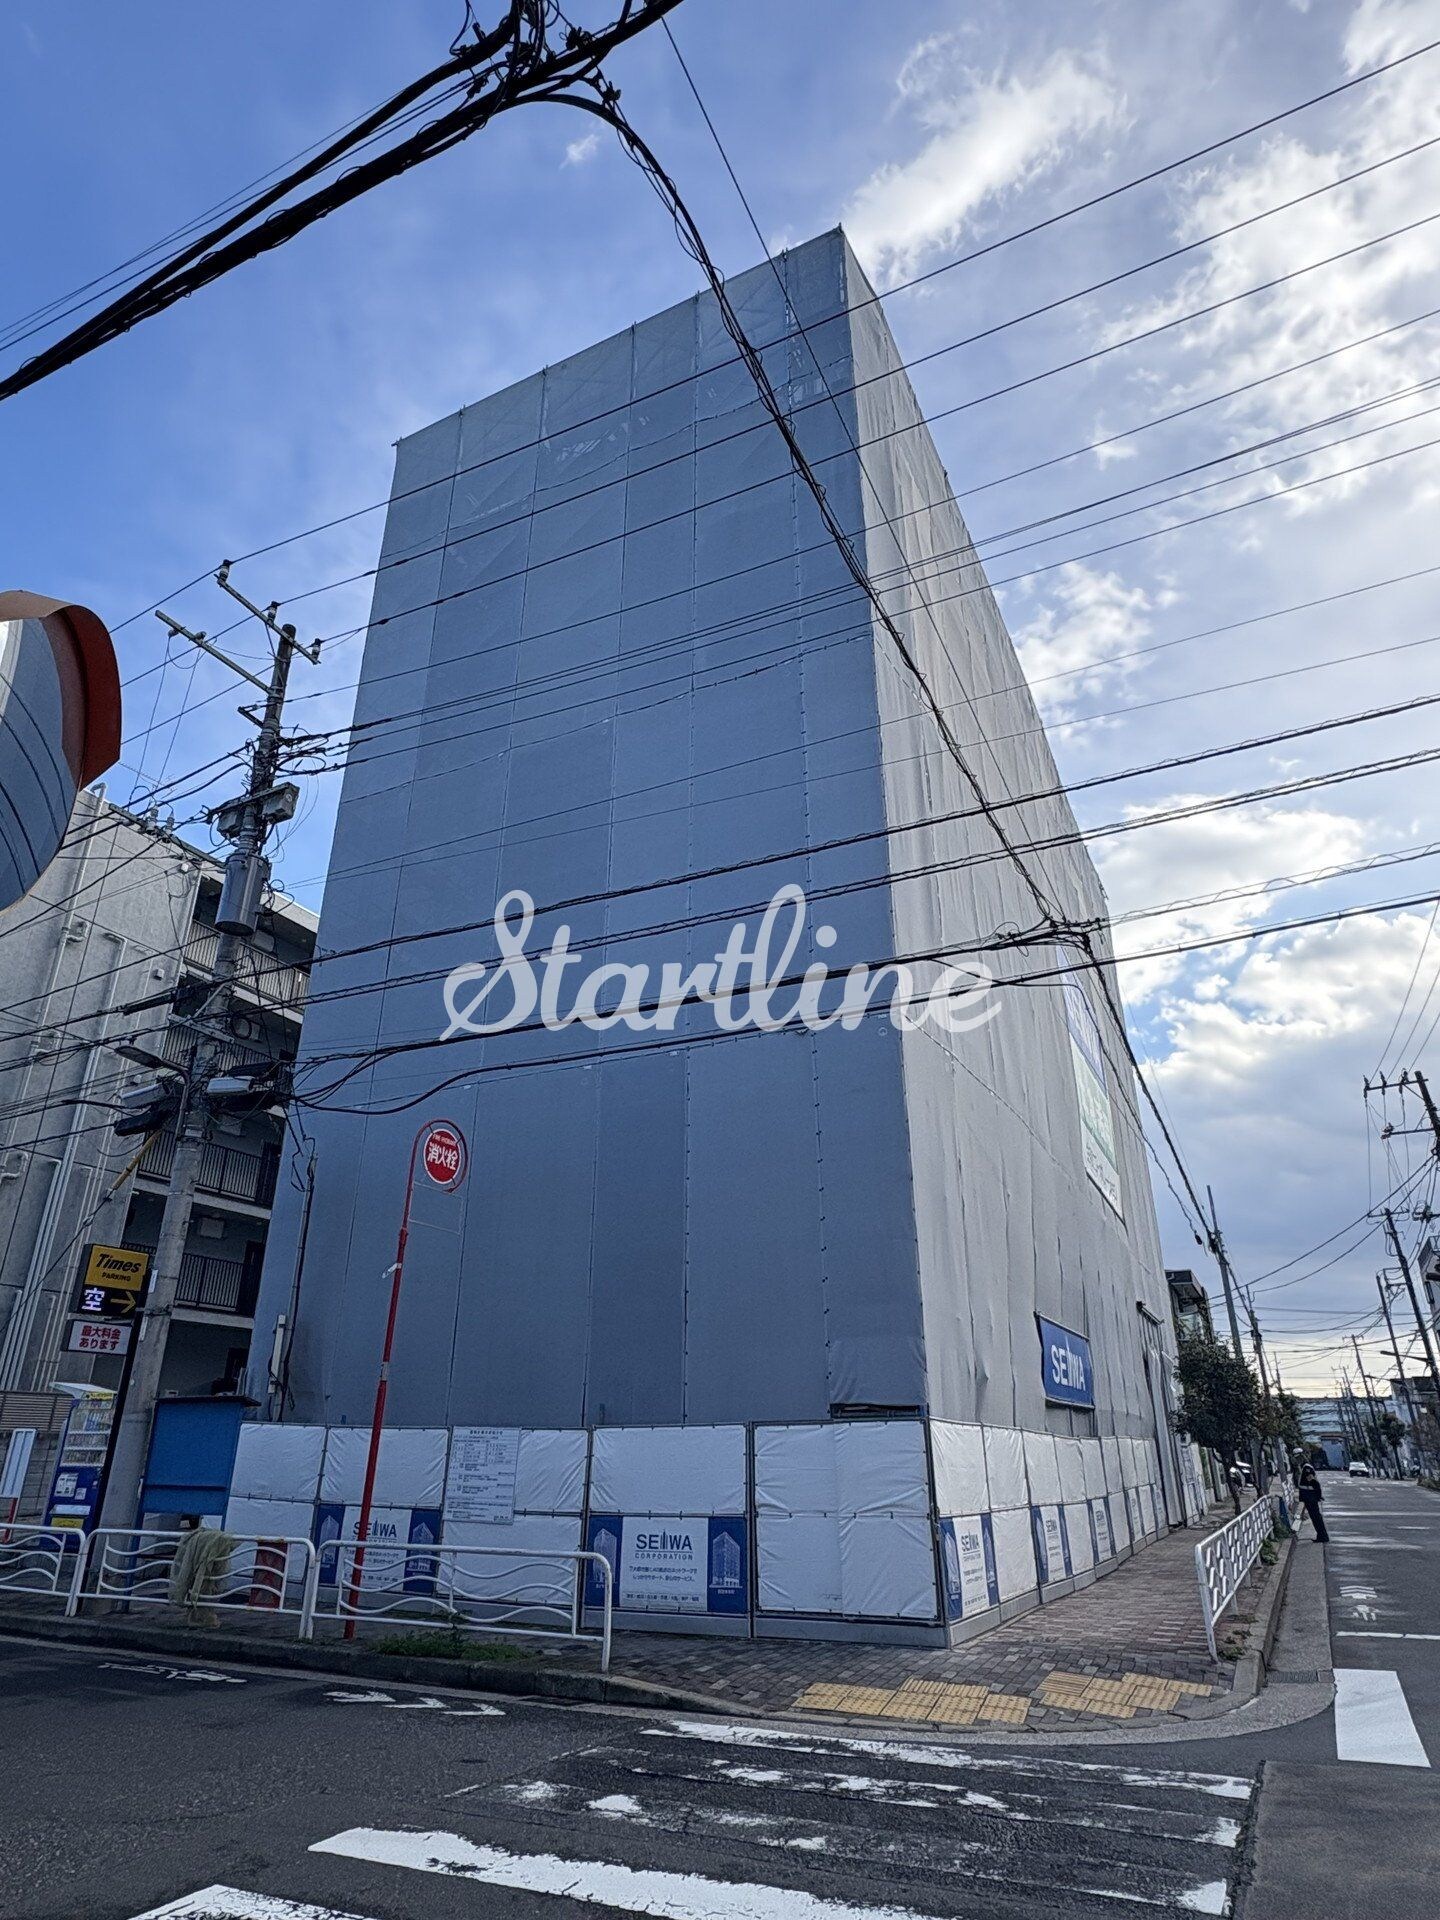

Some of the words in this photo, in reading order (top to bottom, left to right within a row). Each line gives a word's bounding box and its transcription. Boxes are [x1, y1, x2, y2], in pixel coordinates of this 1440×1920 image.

[427, 1141, 458, 1171] 消火栓
[96, 1253, 142, 1274] Times
[101, 1271, 132, 1282] PARKING
[81, 1287, 106, 1312] 空
[81, 1325, 122, 1340] 最大料金
[79, 1337, 120, 1351] あります
[1051, 1336, 1086, 1392] SEIWA
[635, 1529, 693, 1551] SEIWA
[634, 1552, 694, 1561] CORPORATION
